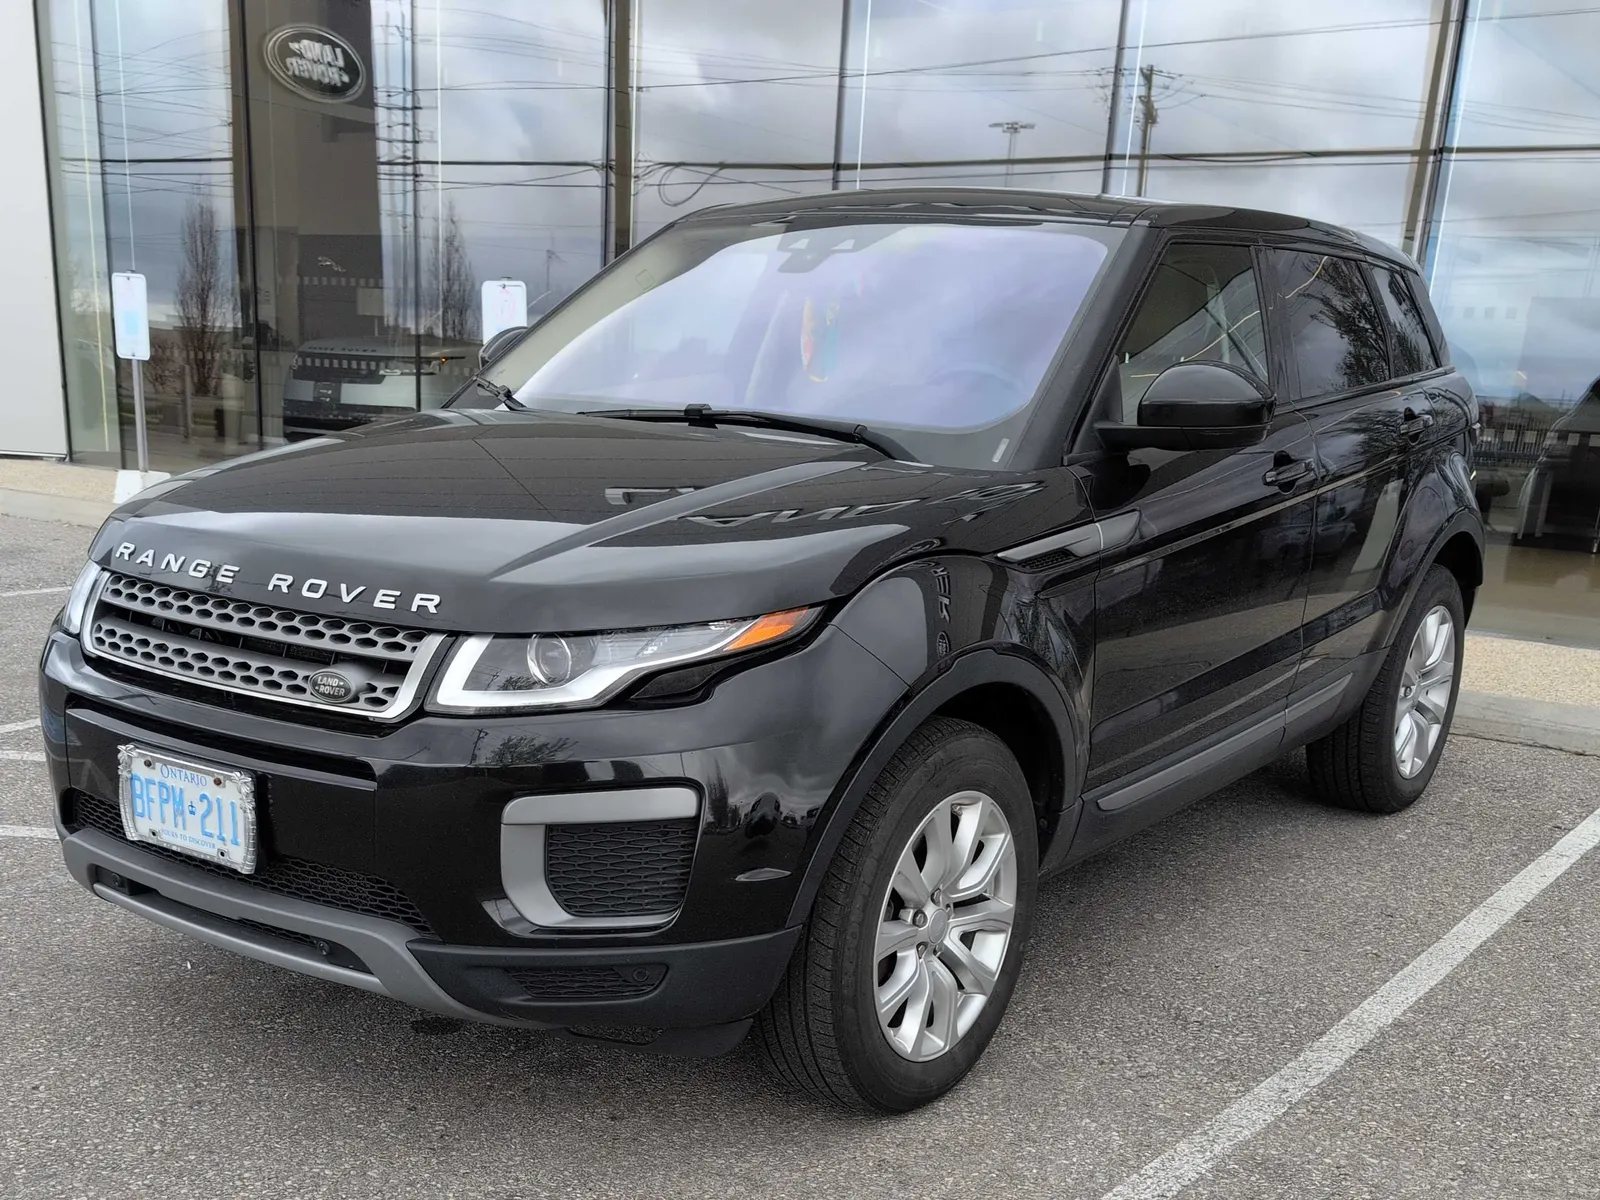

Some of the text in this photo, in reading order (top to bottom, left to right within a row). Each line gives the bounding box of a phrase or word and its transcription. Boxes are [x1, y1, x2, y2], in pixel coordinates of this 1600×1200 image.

[115, 541, 442, 614] RANGE ROVER
[317, 676, 339, 687] LAND
[319, 685, 345, 697] ROVER
[160, 763, 208, 787] ONTARIO
